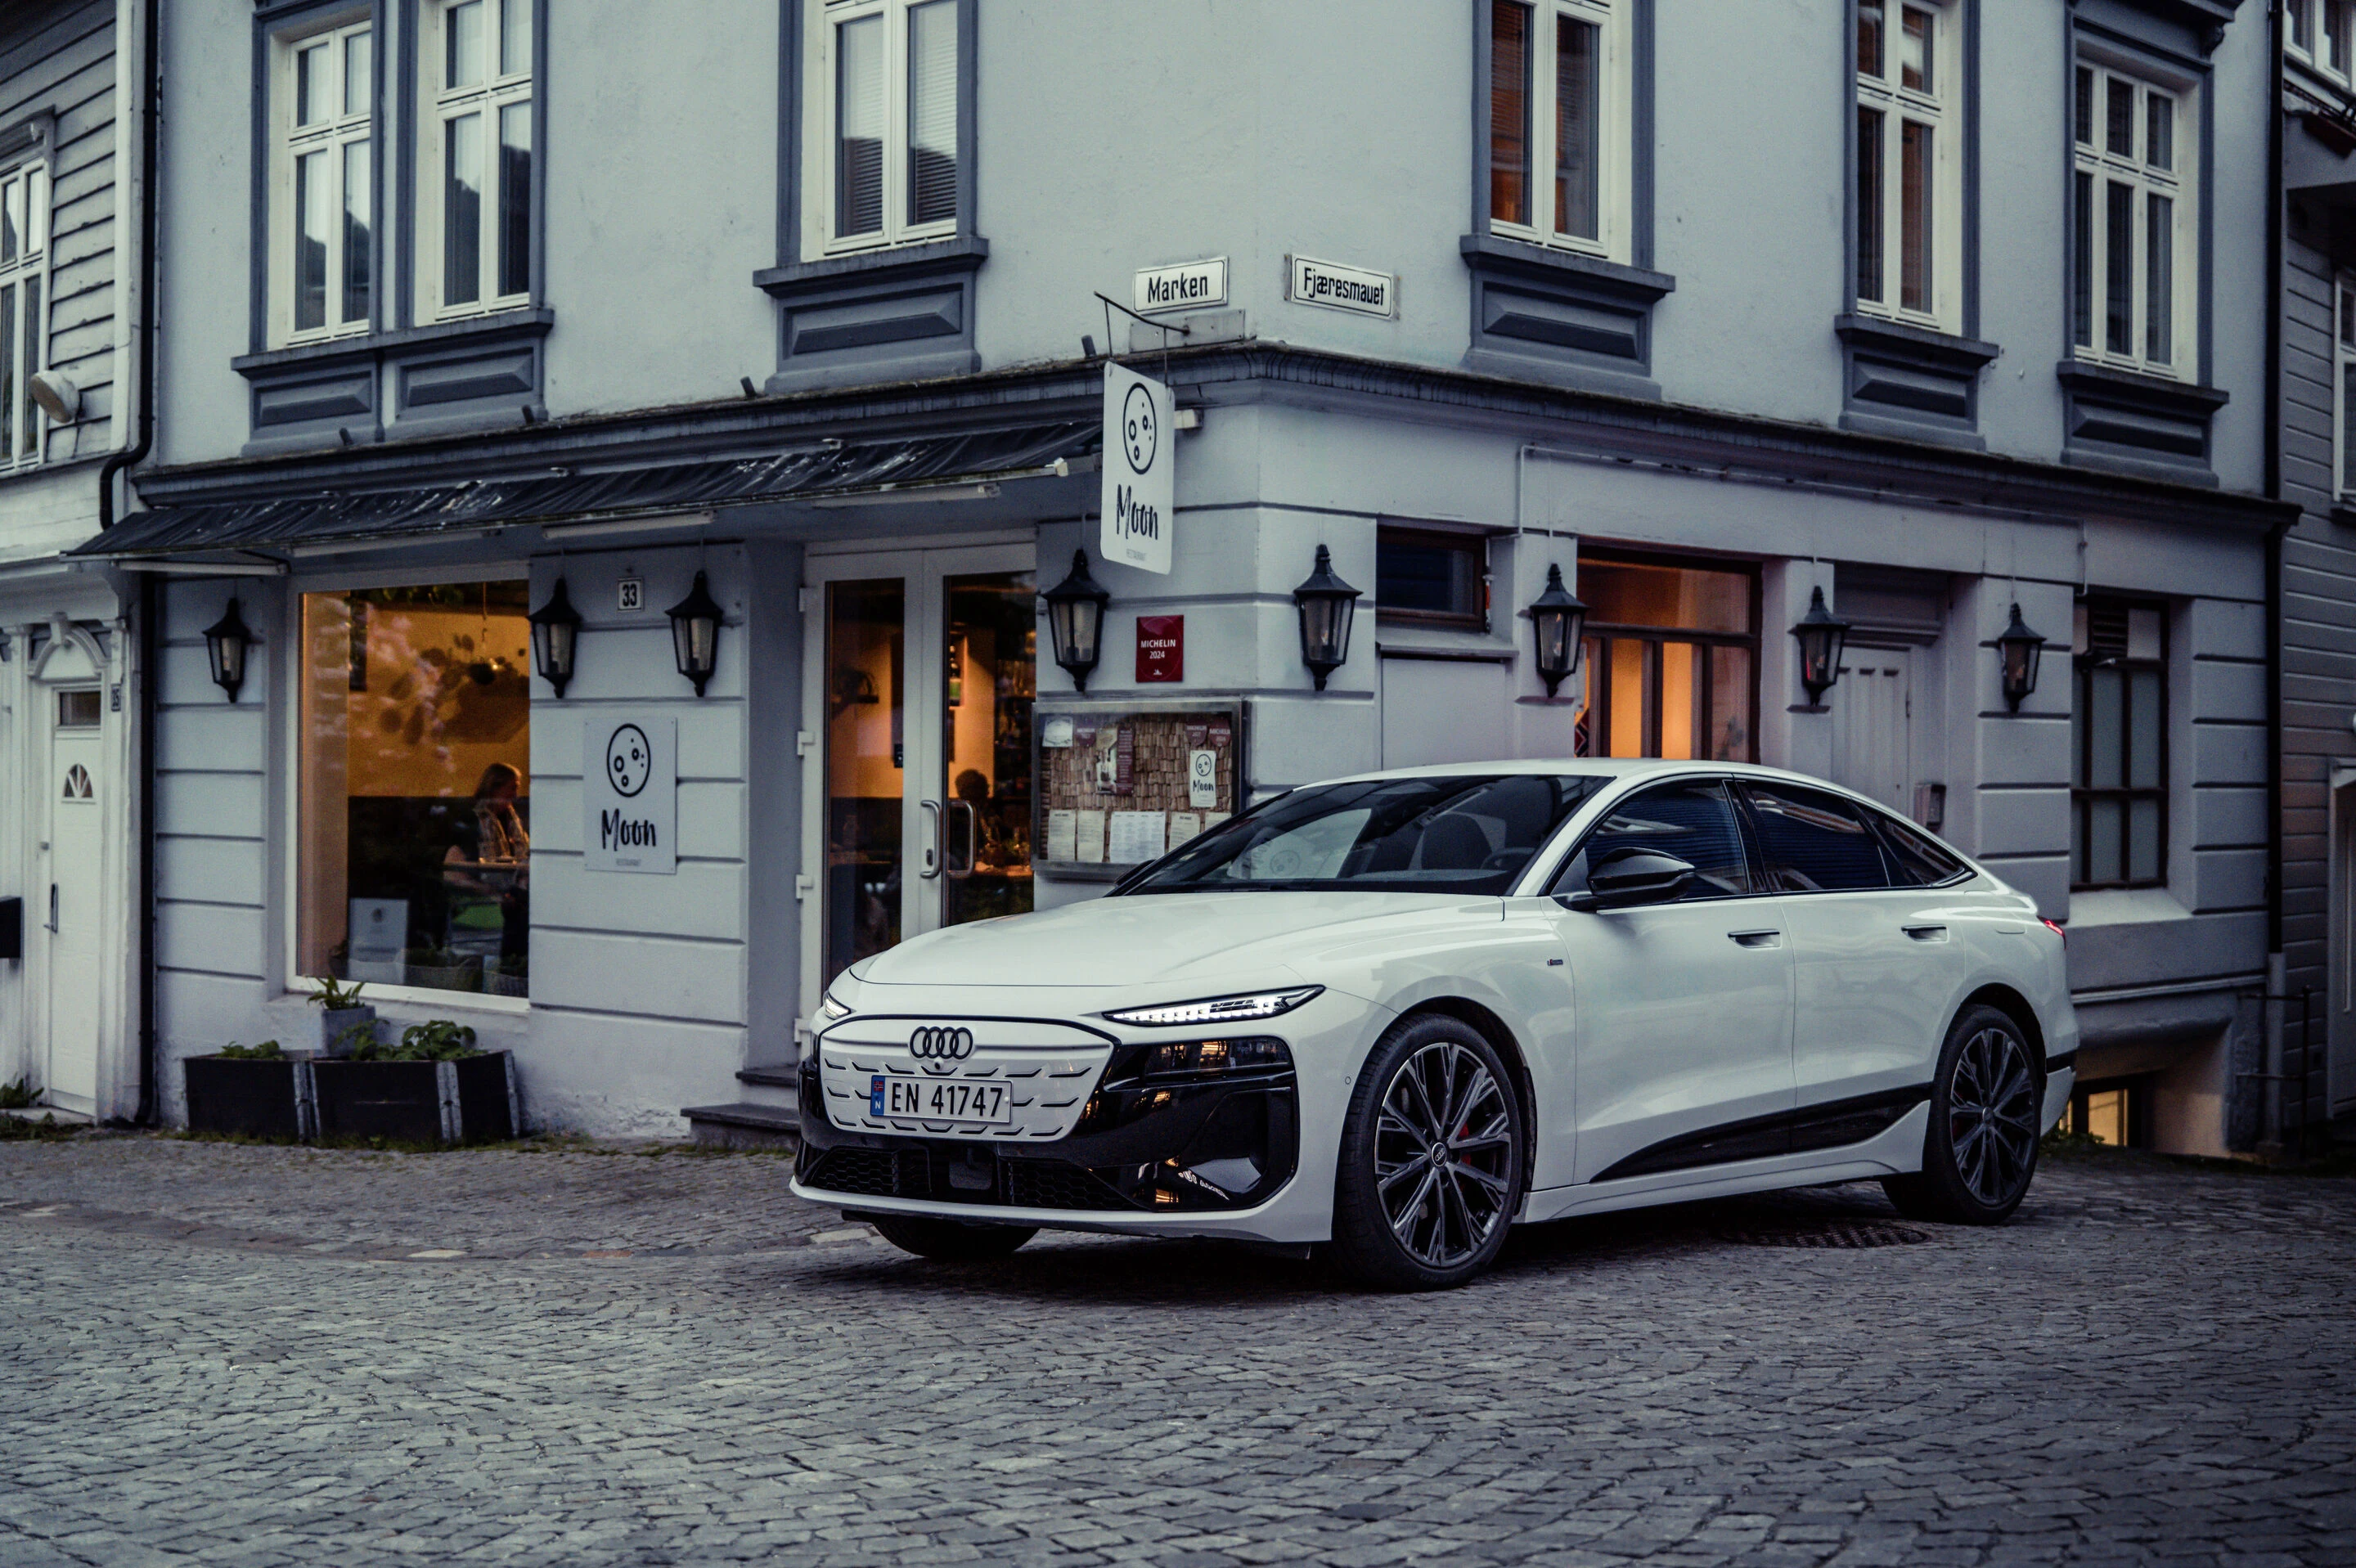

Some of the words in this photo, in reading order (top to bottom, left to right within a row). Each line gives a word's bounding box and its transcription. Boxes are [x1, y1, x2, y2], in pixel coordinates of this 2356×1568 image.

[1148, 272, 1208, 303] Marken
[1303, 267, 1385, 306] Fjæresmauet
[1117, 484, 1158, 541] Moon
[622, 583, 637, 607] 33
[1140, 639, 1176, 648] MICHELIN
[1149, 651, 1165, 659] 2024
[1193, 780, 1213, 793] Moon
[602, 808, 656, 851] Moon
[875, 1100, 881, 1110] N
[891, 1082, 919, 1113] EN
[931, 1085, 1003, 1117] 41747
